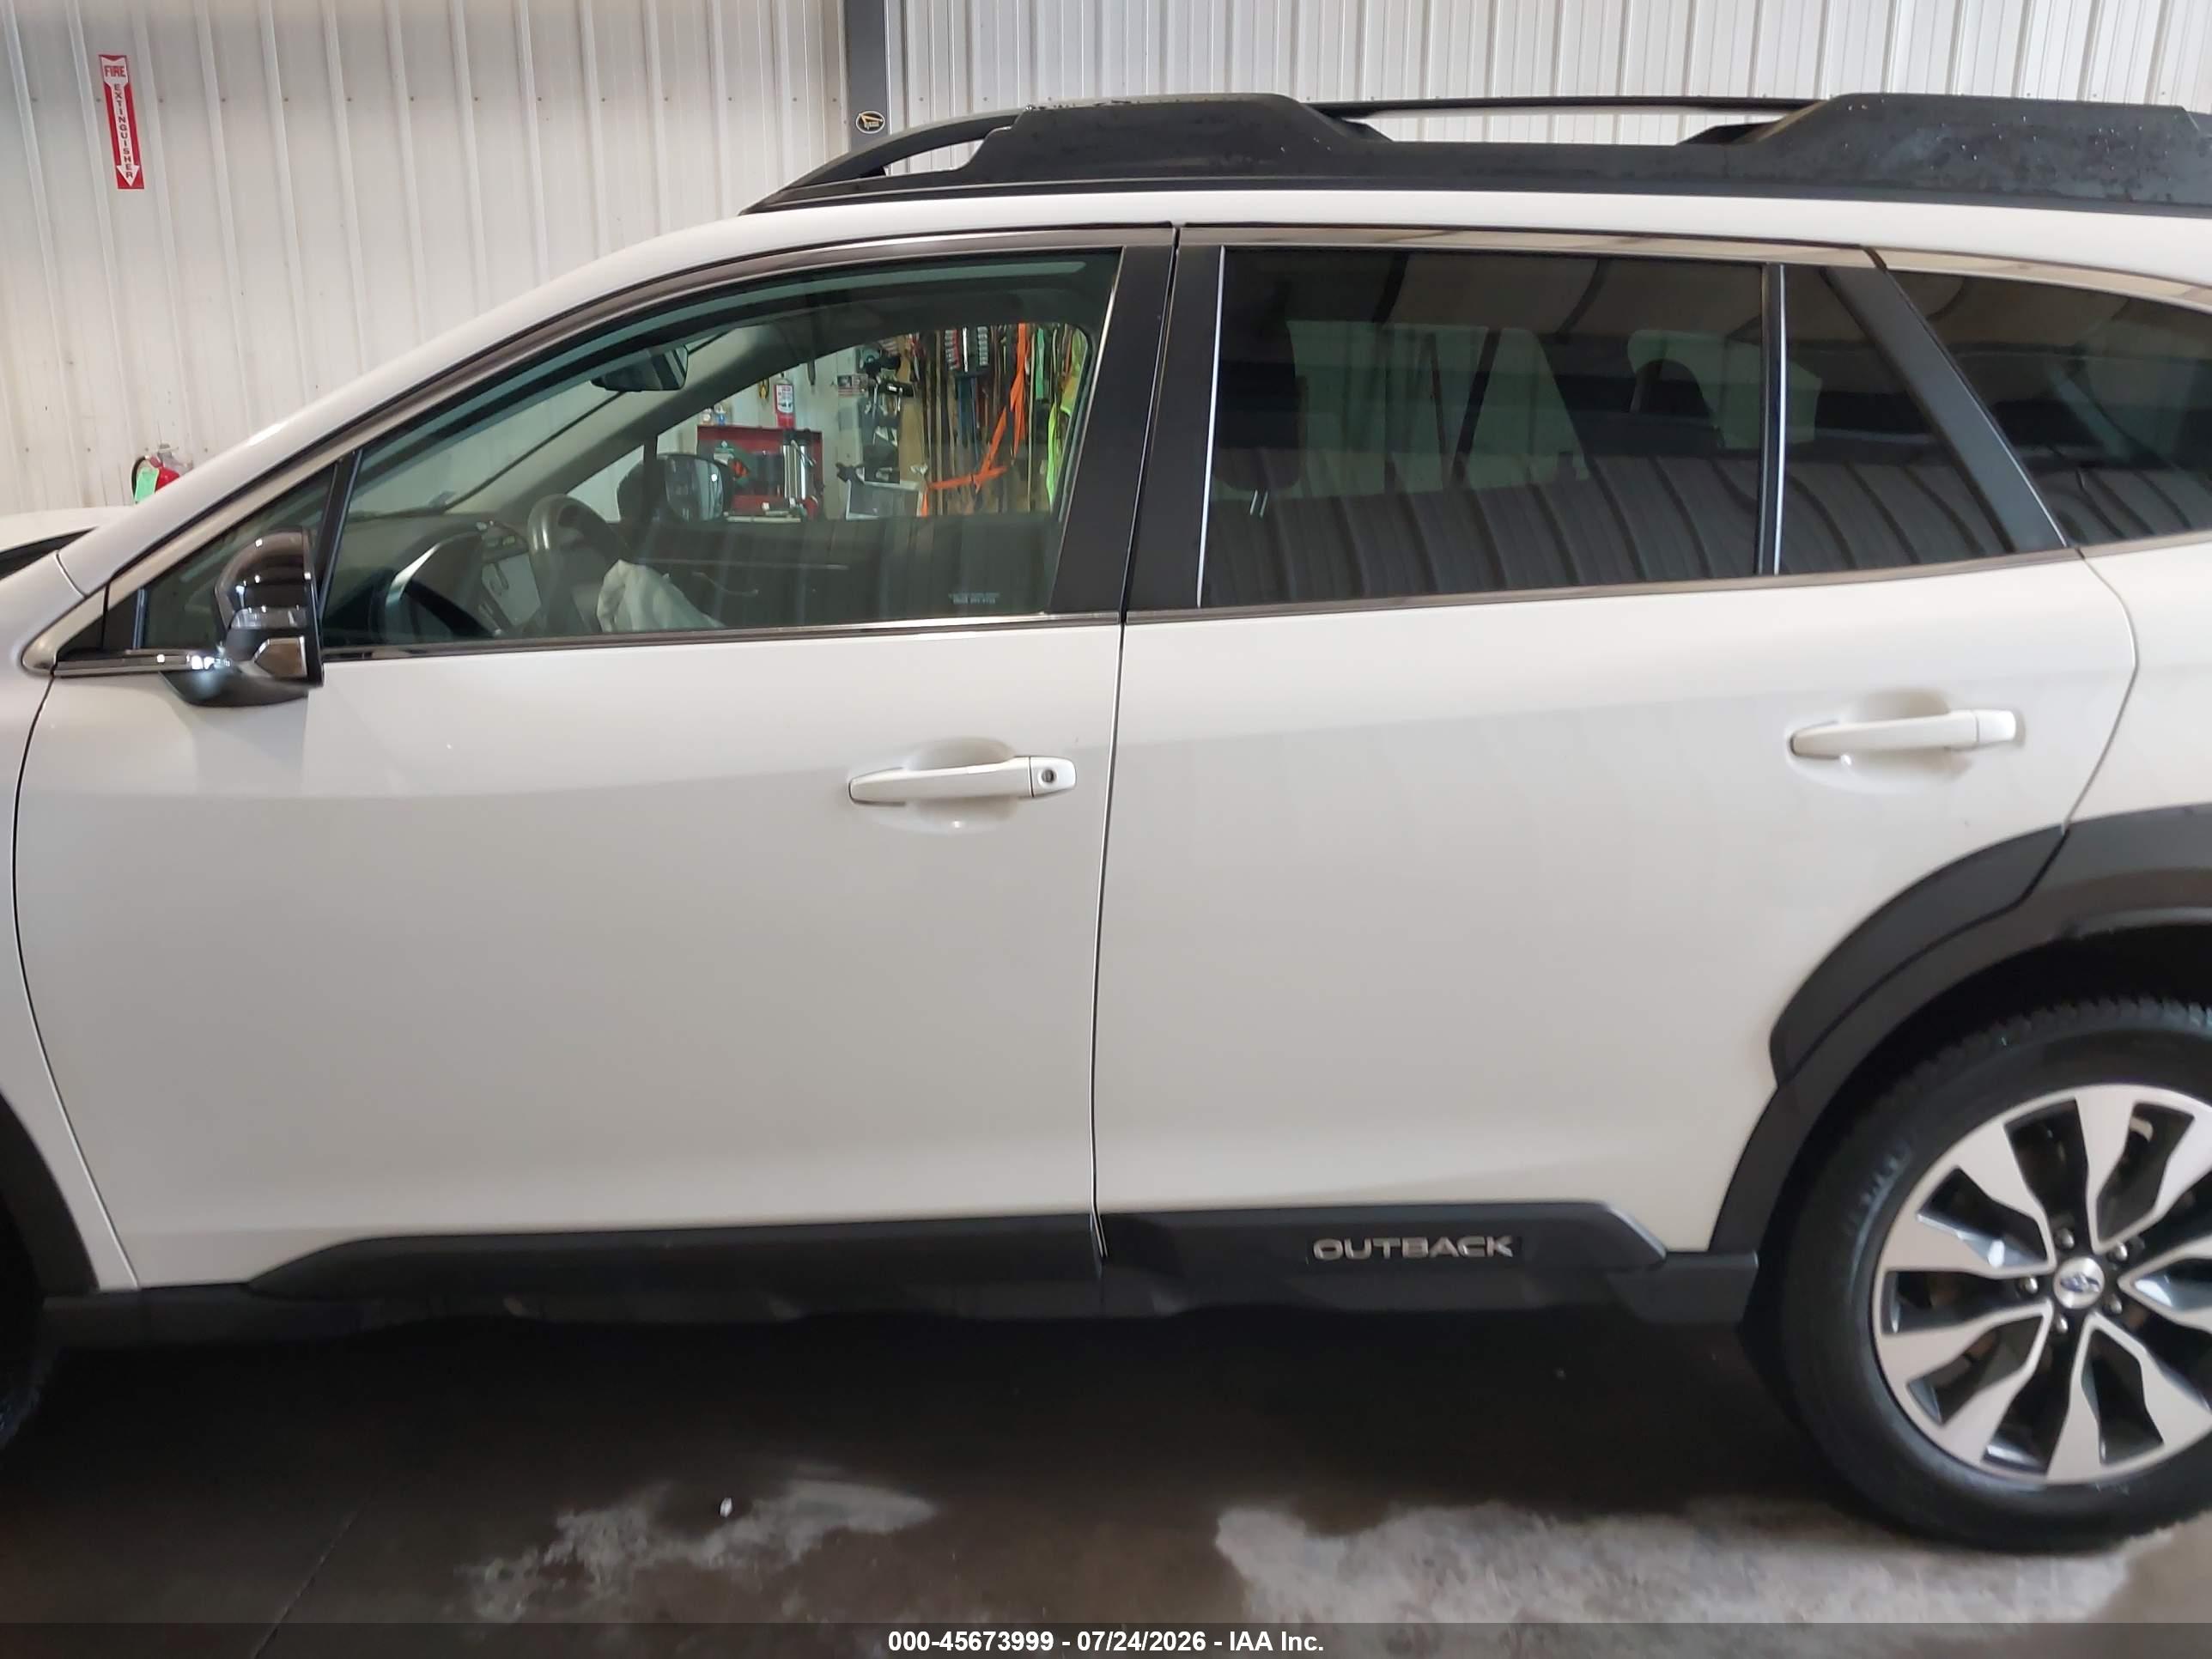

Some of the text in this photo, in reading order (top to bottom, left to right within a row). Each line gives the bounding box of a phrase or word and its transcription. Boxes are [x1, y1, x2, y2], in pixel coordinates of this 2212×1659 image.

[104, 65, 126, 78] FIRE
[113, 83, 134, 179] EXTINGUISHER
[1313, 1236, 1514, 1261] OUTBACK
